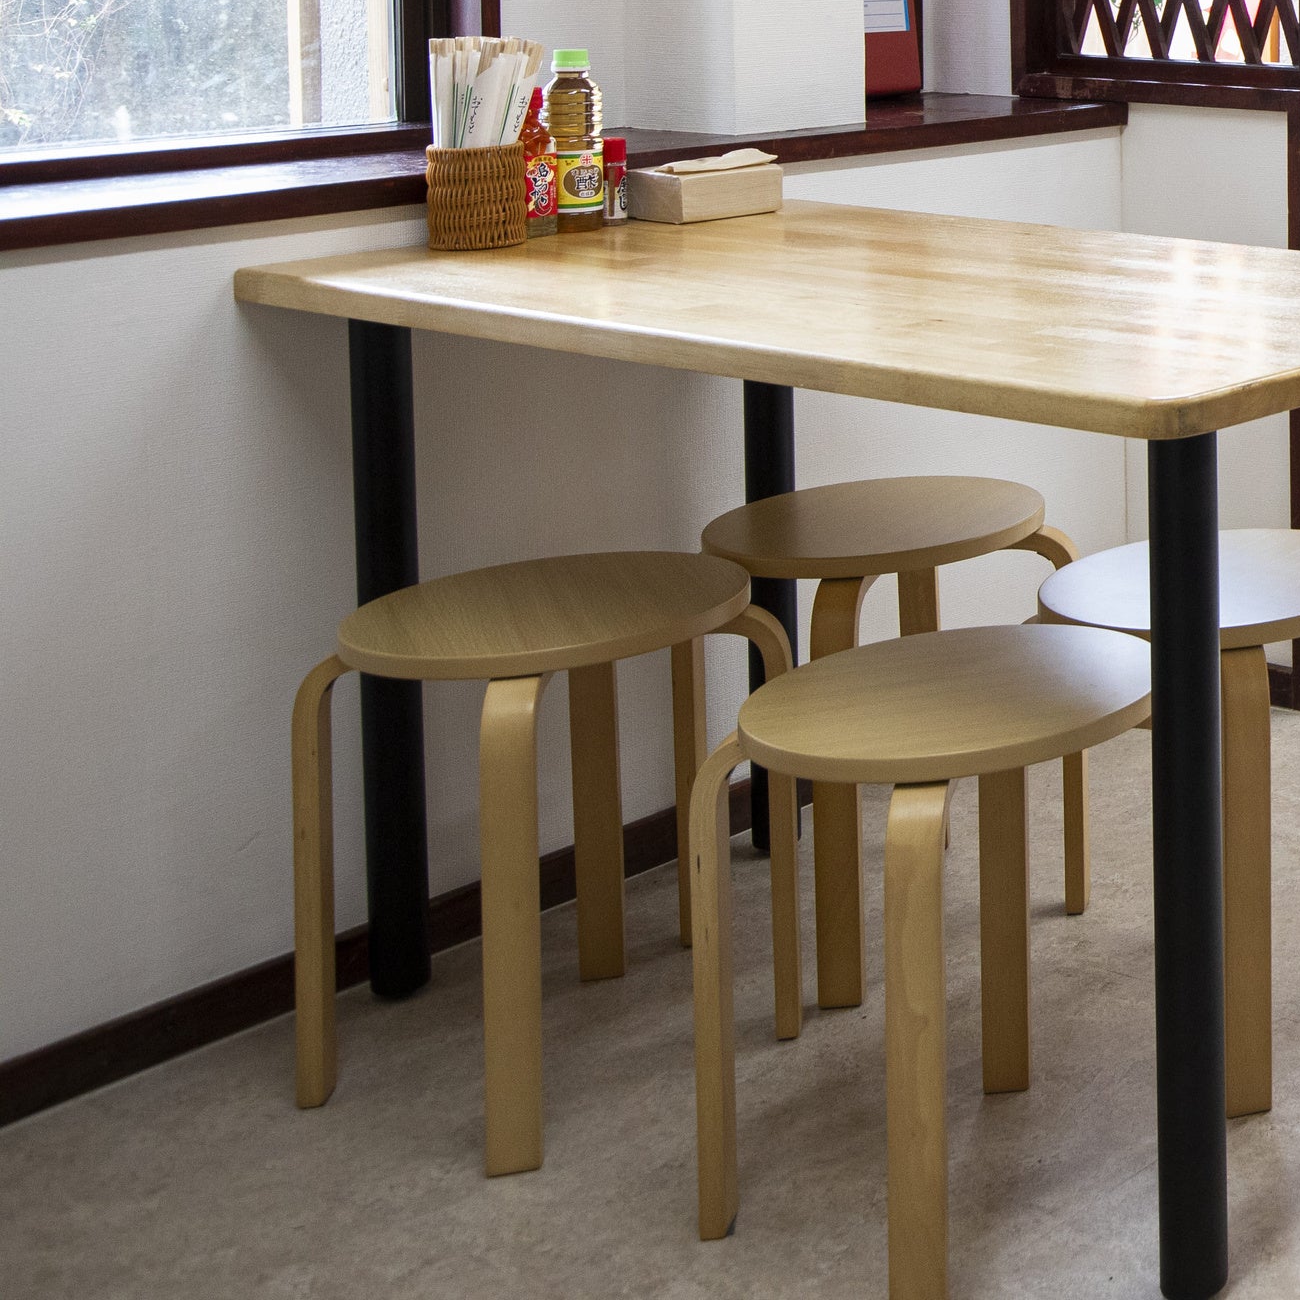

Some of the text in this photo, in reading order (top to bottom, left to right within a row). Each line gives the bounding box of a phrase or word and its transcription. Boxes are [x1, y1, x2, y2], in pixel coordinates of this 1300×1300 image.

[530, 162, 552, 216] 島とうがらし
[576, 174, 598, 190] 酢
